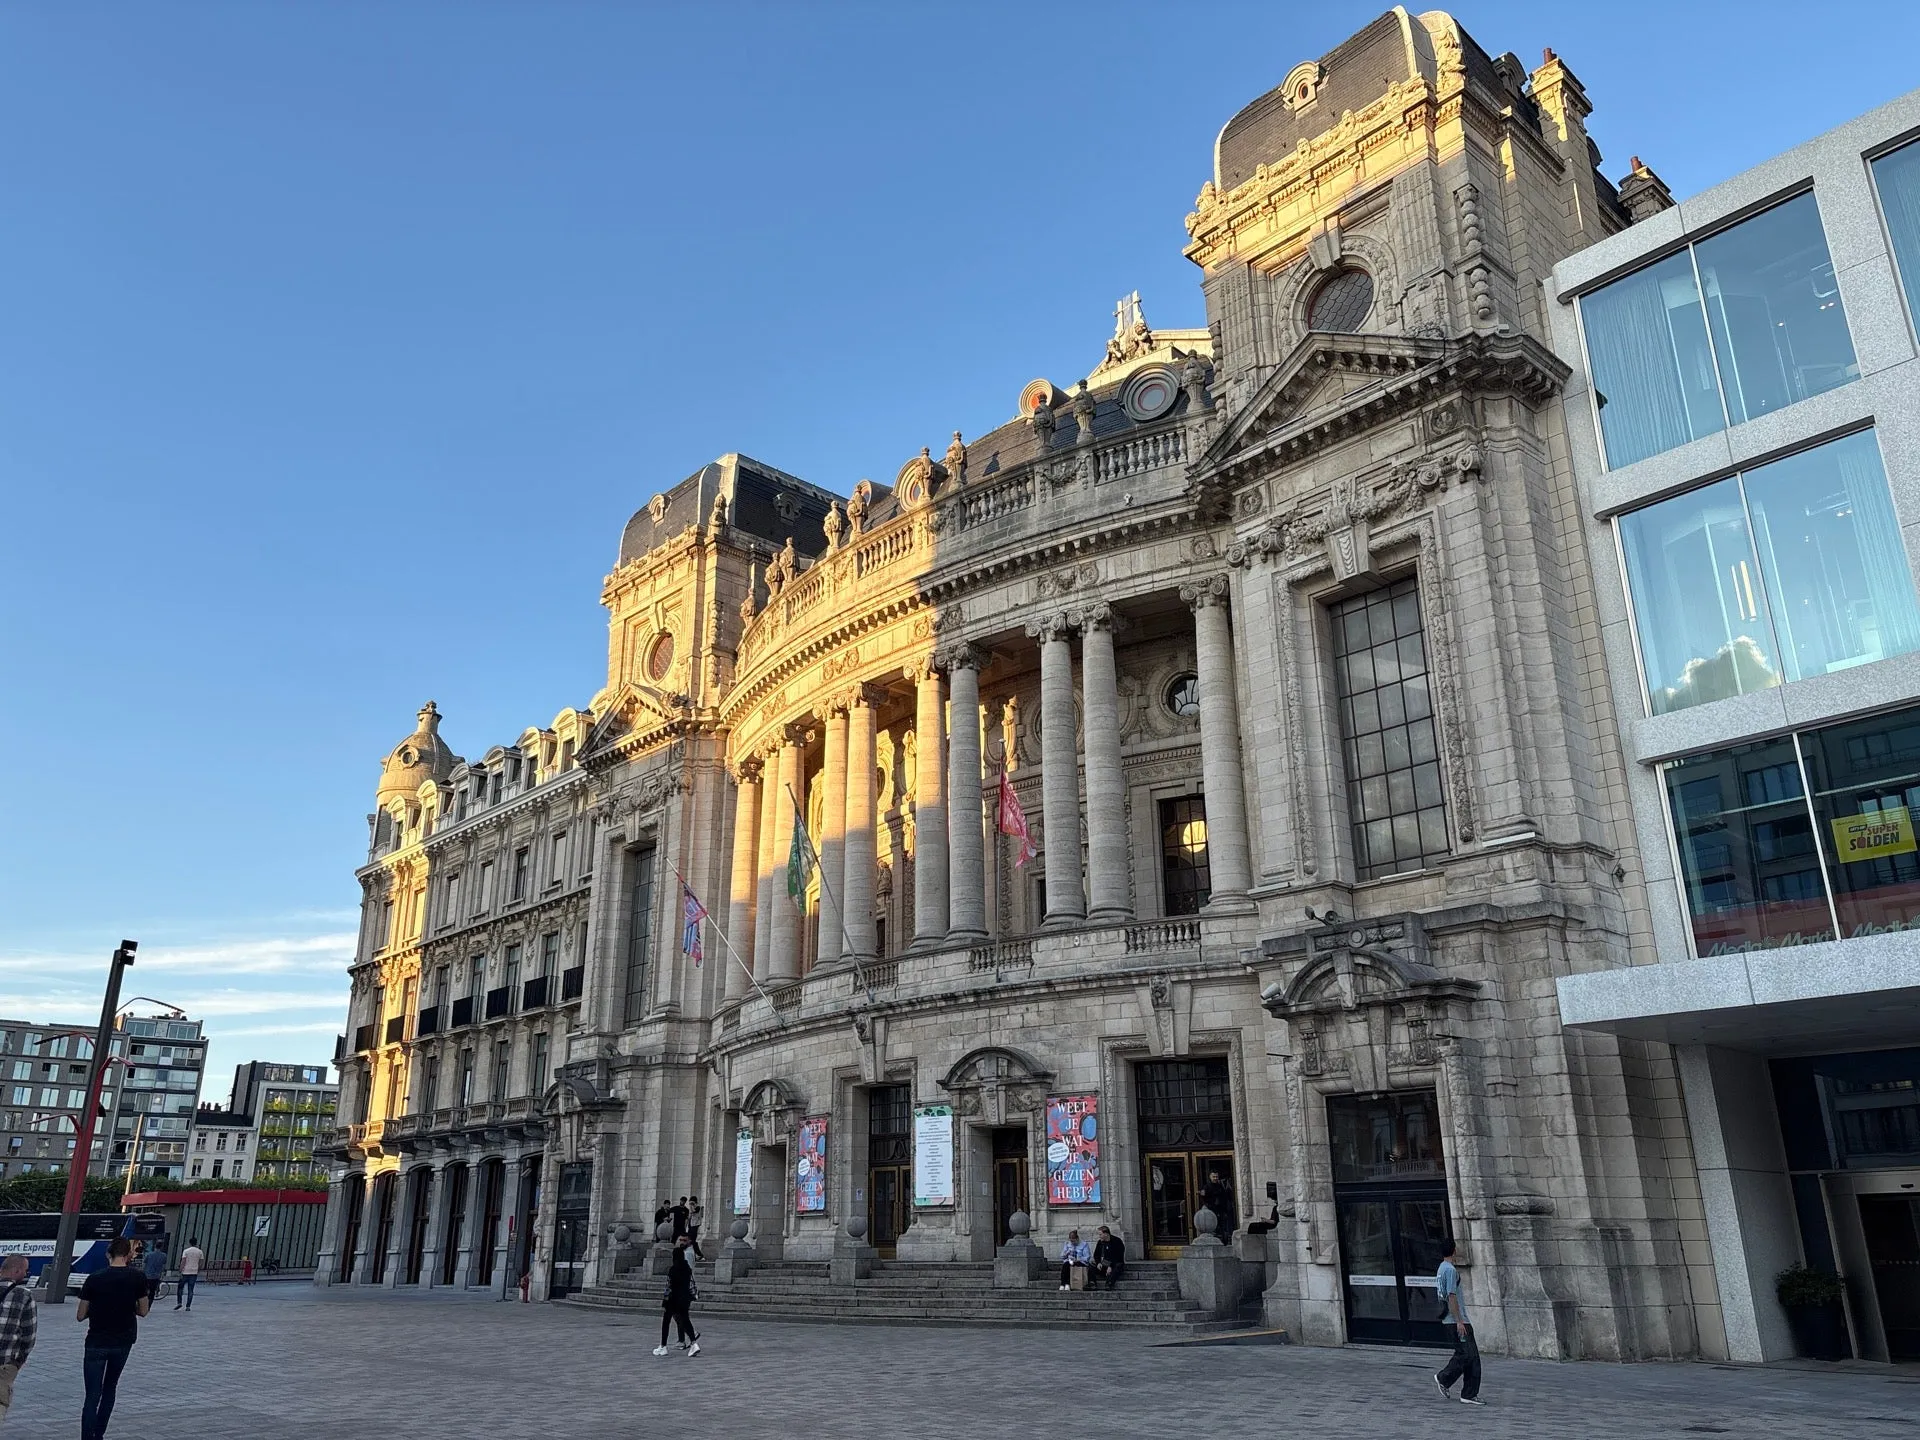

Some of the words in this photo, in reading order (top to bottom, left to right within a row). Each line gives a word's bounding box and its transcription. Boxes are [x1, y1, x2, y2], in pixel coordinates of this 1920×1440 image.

[1867, 822, 1899, 835] SUPER
[1850, 832, 1900, 850] SOLDEN
[1850, 920, 1911, 938] Media
[1707, 940, 1762, 957] Media
[1780, 930, 1832, 948] Markt
[1057, 1101, 1088, 1113] WEET
[804, 1123, 822, 1134] WEET
[1065, 1118, 1079, 1130] JE
[808, 1137, 816, 1148] JE
[1062, 1135, 1084, 1147] WAT
[1066, 1152, 1080, 1164] JE
[1053, 1168, 1095, 1182] GEZIEN
[800, 1181, 823, 1193] GEZIEN
[1057, 1186, 1093, 1199] HEBT?
[23, 1243, 55, 1254] Express
